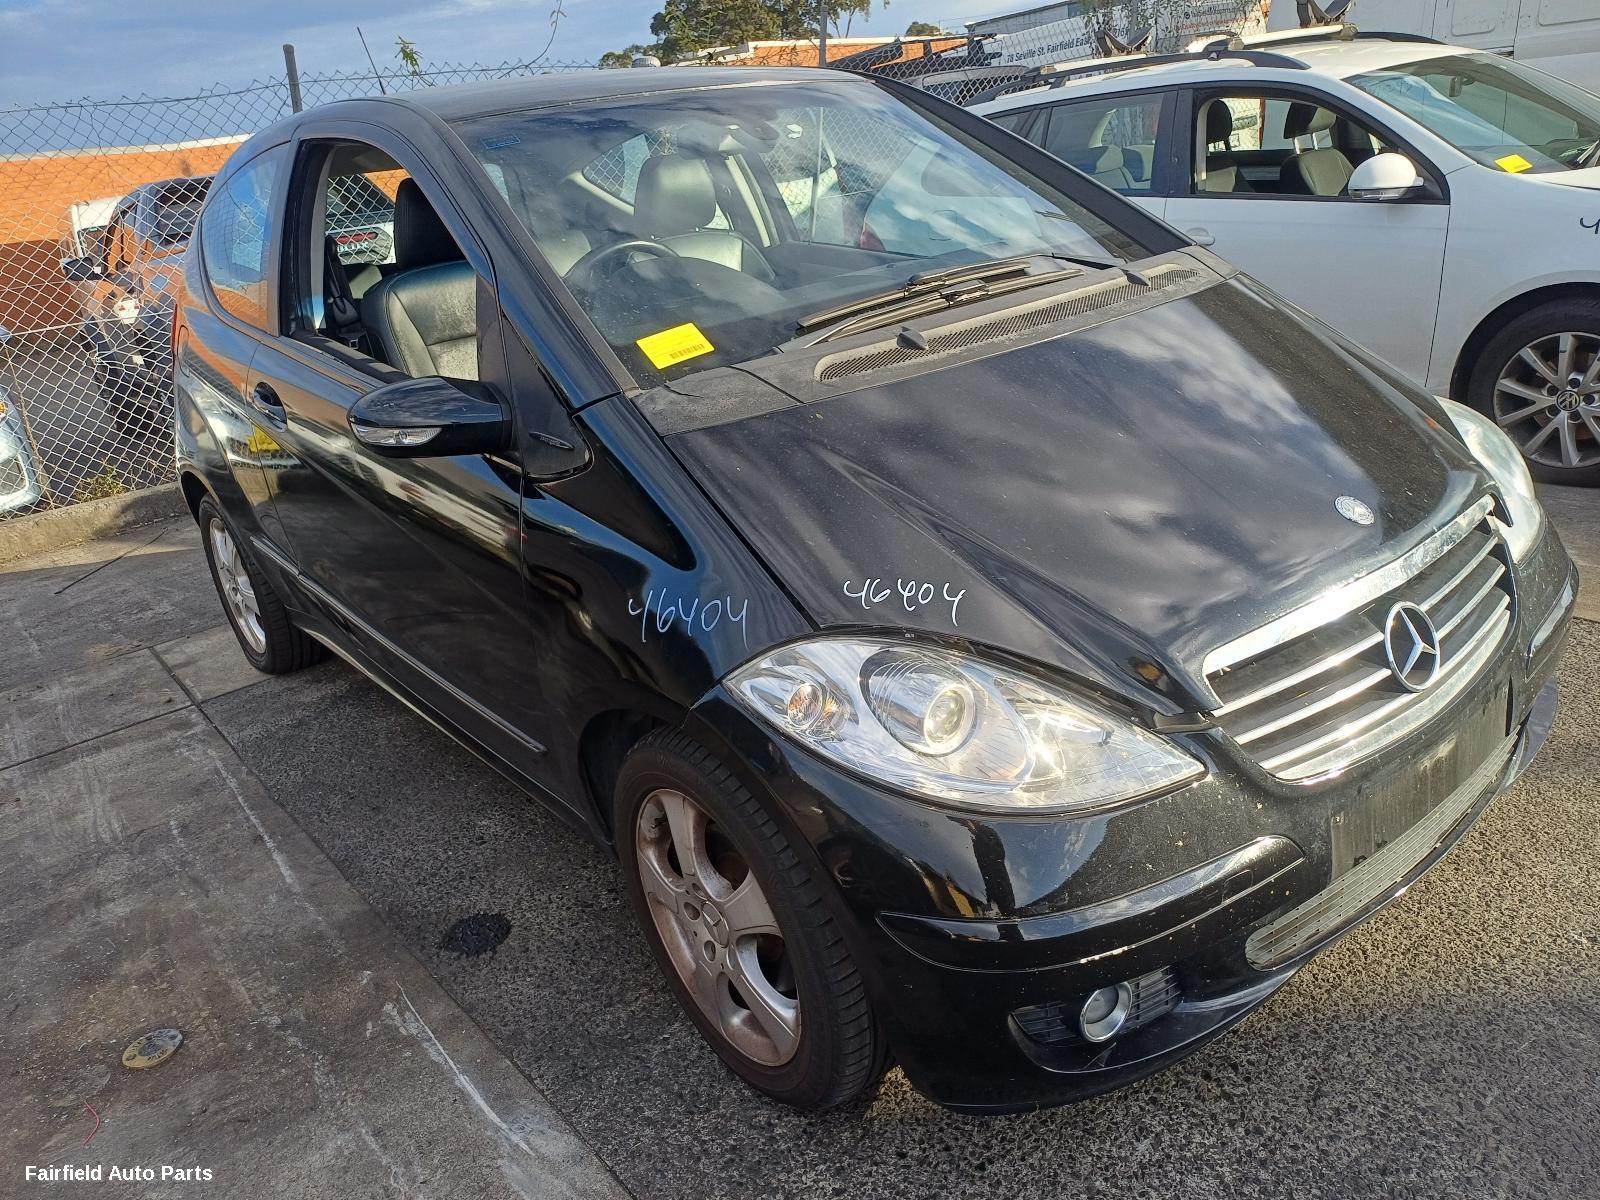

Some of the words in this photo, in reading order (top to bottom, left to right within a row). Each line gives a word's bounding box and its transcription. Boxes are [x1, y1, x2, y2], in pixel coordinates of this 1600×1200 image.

[1015, 48, 1037, 62] Seville
[1047, 39, 1075, 54] Fairfield
[628, 587, 749, 647] 46404
[843, 577, 967, 627] 46404
